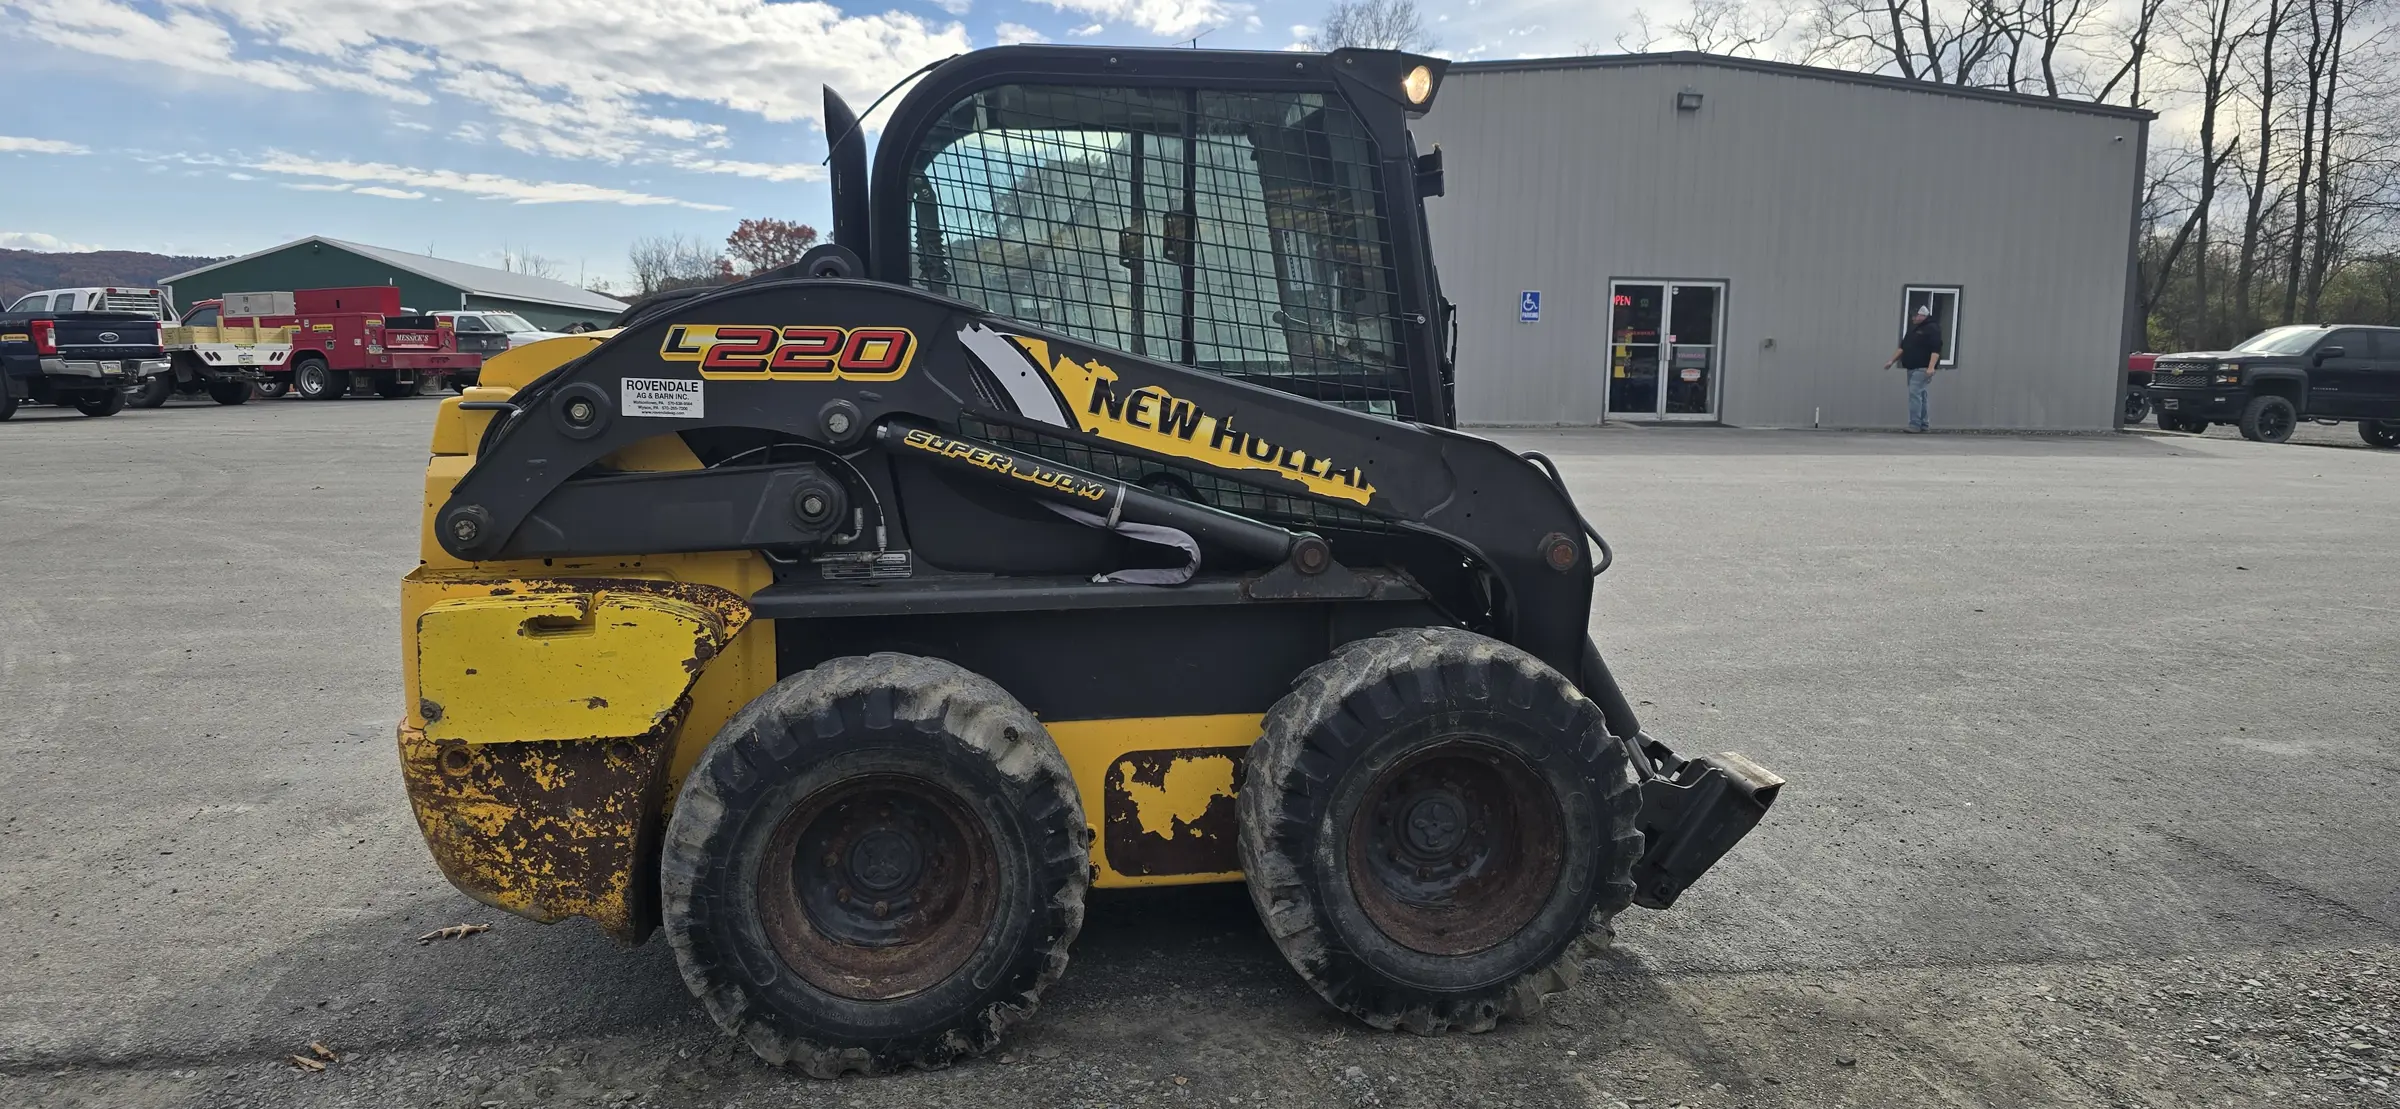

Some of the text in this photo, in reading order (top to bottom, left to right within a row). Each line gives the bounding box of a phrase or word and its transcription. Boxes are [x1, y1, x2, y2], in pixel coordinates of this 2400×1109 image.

[626, 380, 699, 392] ROVENDALE
[1088, 377, 1207, 441] NEW
[904, 429, 1013, 474] SUPER
